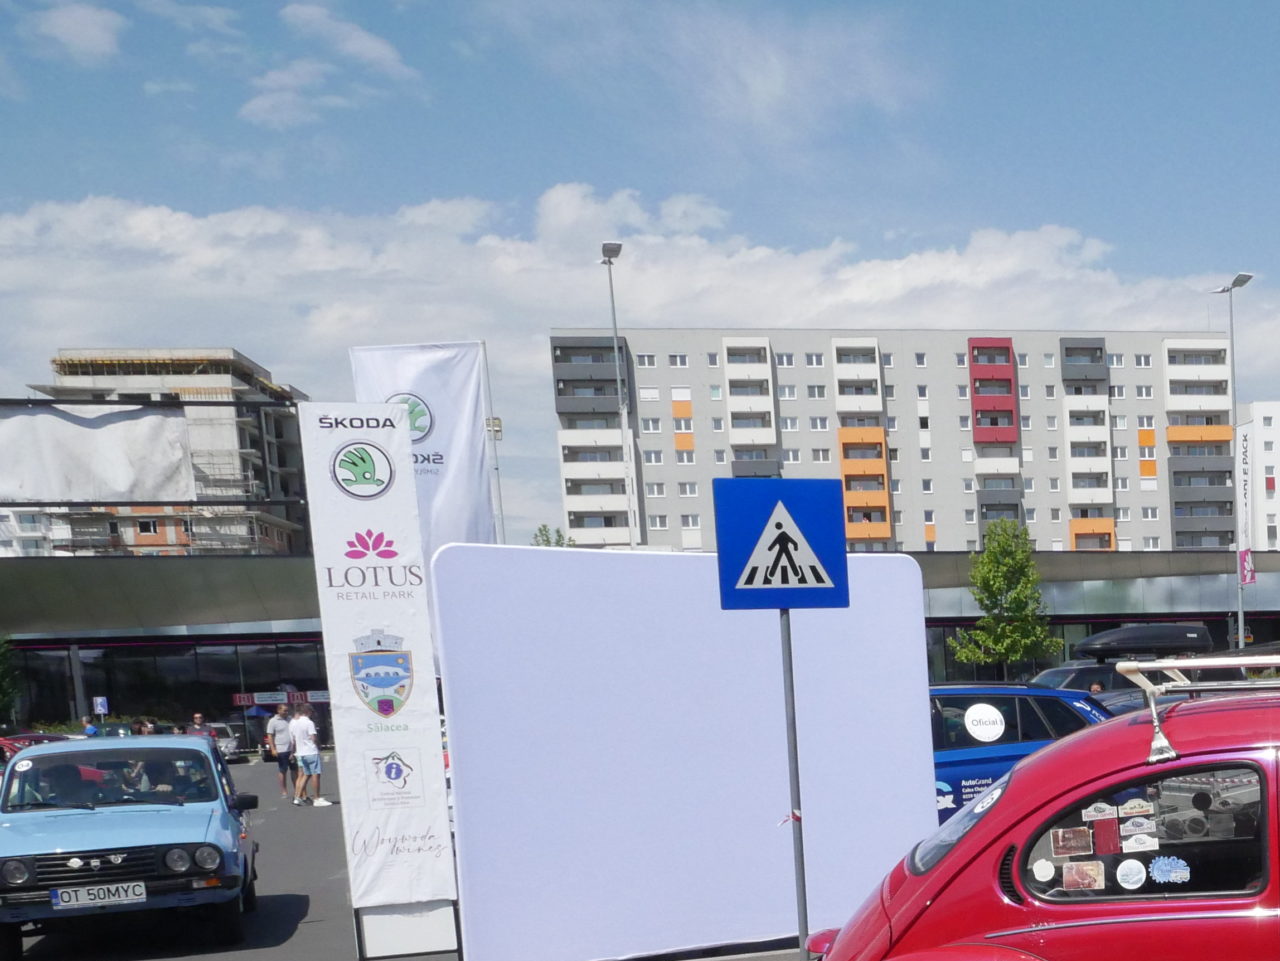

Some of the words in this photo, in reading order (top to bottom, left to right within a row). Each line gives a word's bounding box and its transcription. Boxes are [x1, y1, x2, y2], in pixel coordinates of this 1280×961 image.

[318, 415, 396, 429] ŠKODA
[325, 565, 423, 588] LOTUS
[337, 591, 380, 601] RETAIL
[383, 590, 415, 600] PARK
[60, 889, 80, 903] OT
[87, 884, 143, 901] 50MYC
